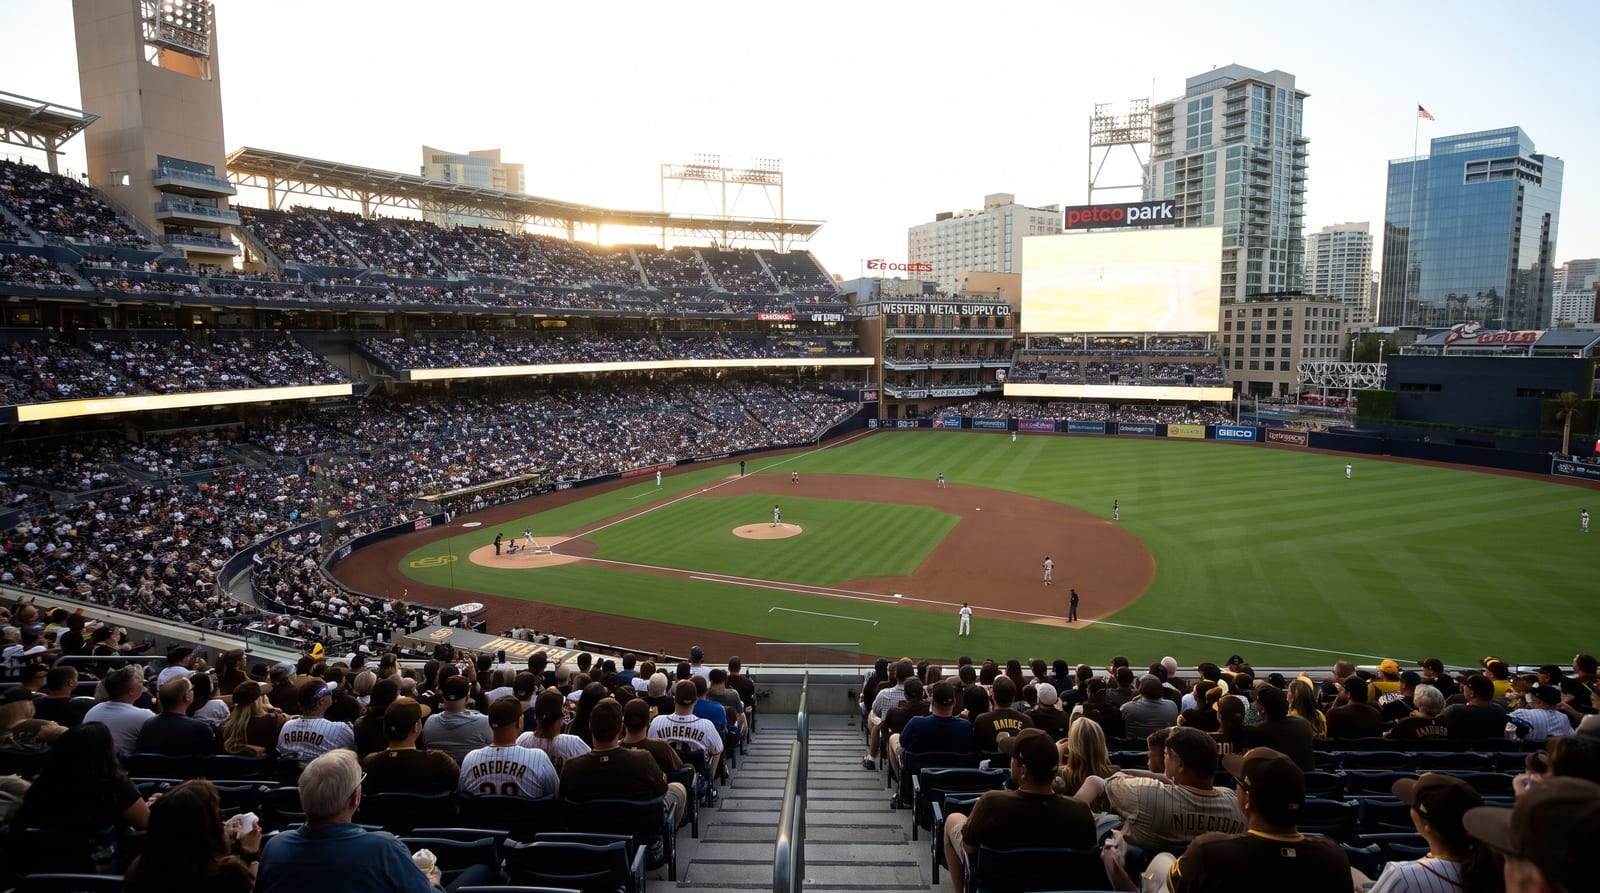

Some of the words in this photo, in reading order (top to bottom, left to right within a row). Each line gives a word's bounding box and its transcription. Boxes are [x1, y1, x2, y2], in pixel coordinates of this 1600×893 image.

[1067, 207, 1124, 229] petco
[1126, 202, 1173, 225] park
[882, 303, 926, 314] WESTERN
[930, 304, 960, 315] METAL
[961, 305, 995, 316] SUPPLY
[996, 306, 1011, 316] CO.
[1218, 429, 1252, 438] GEICO
